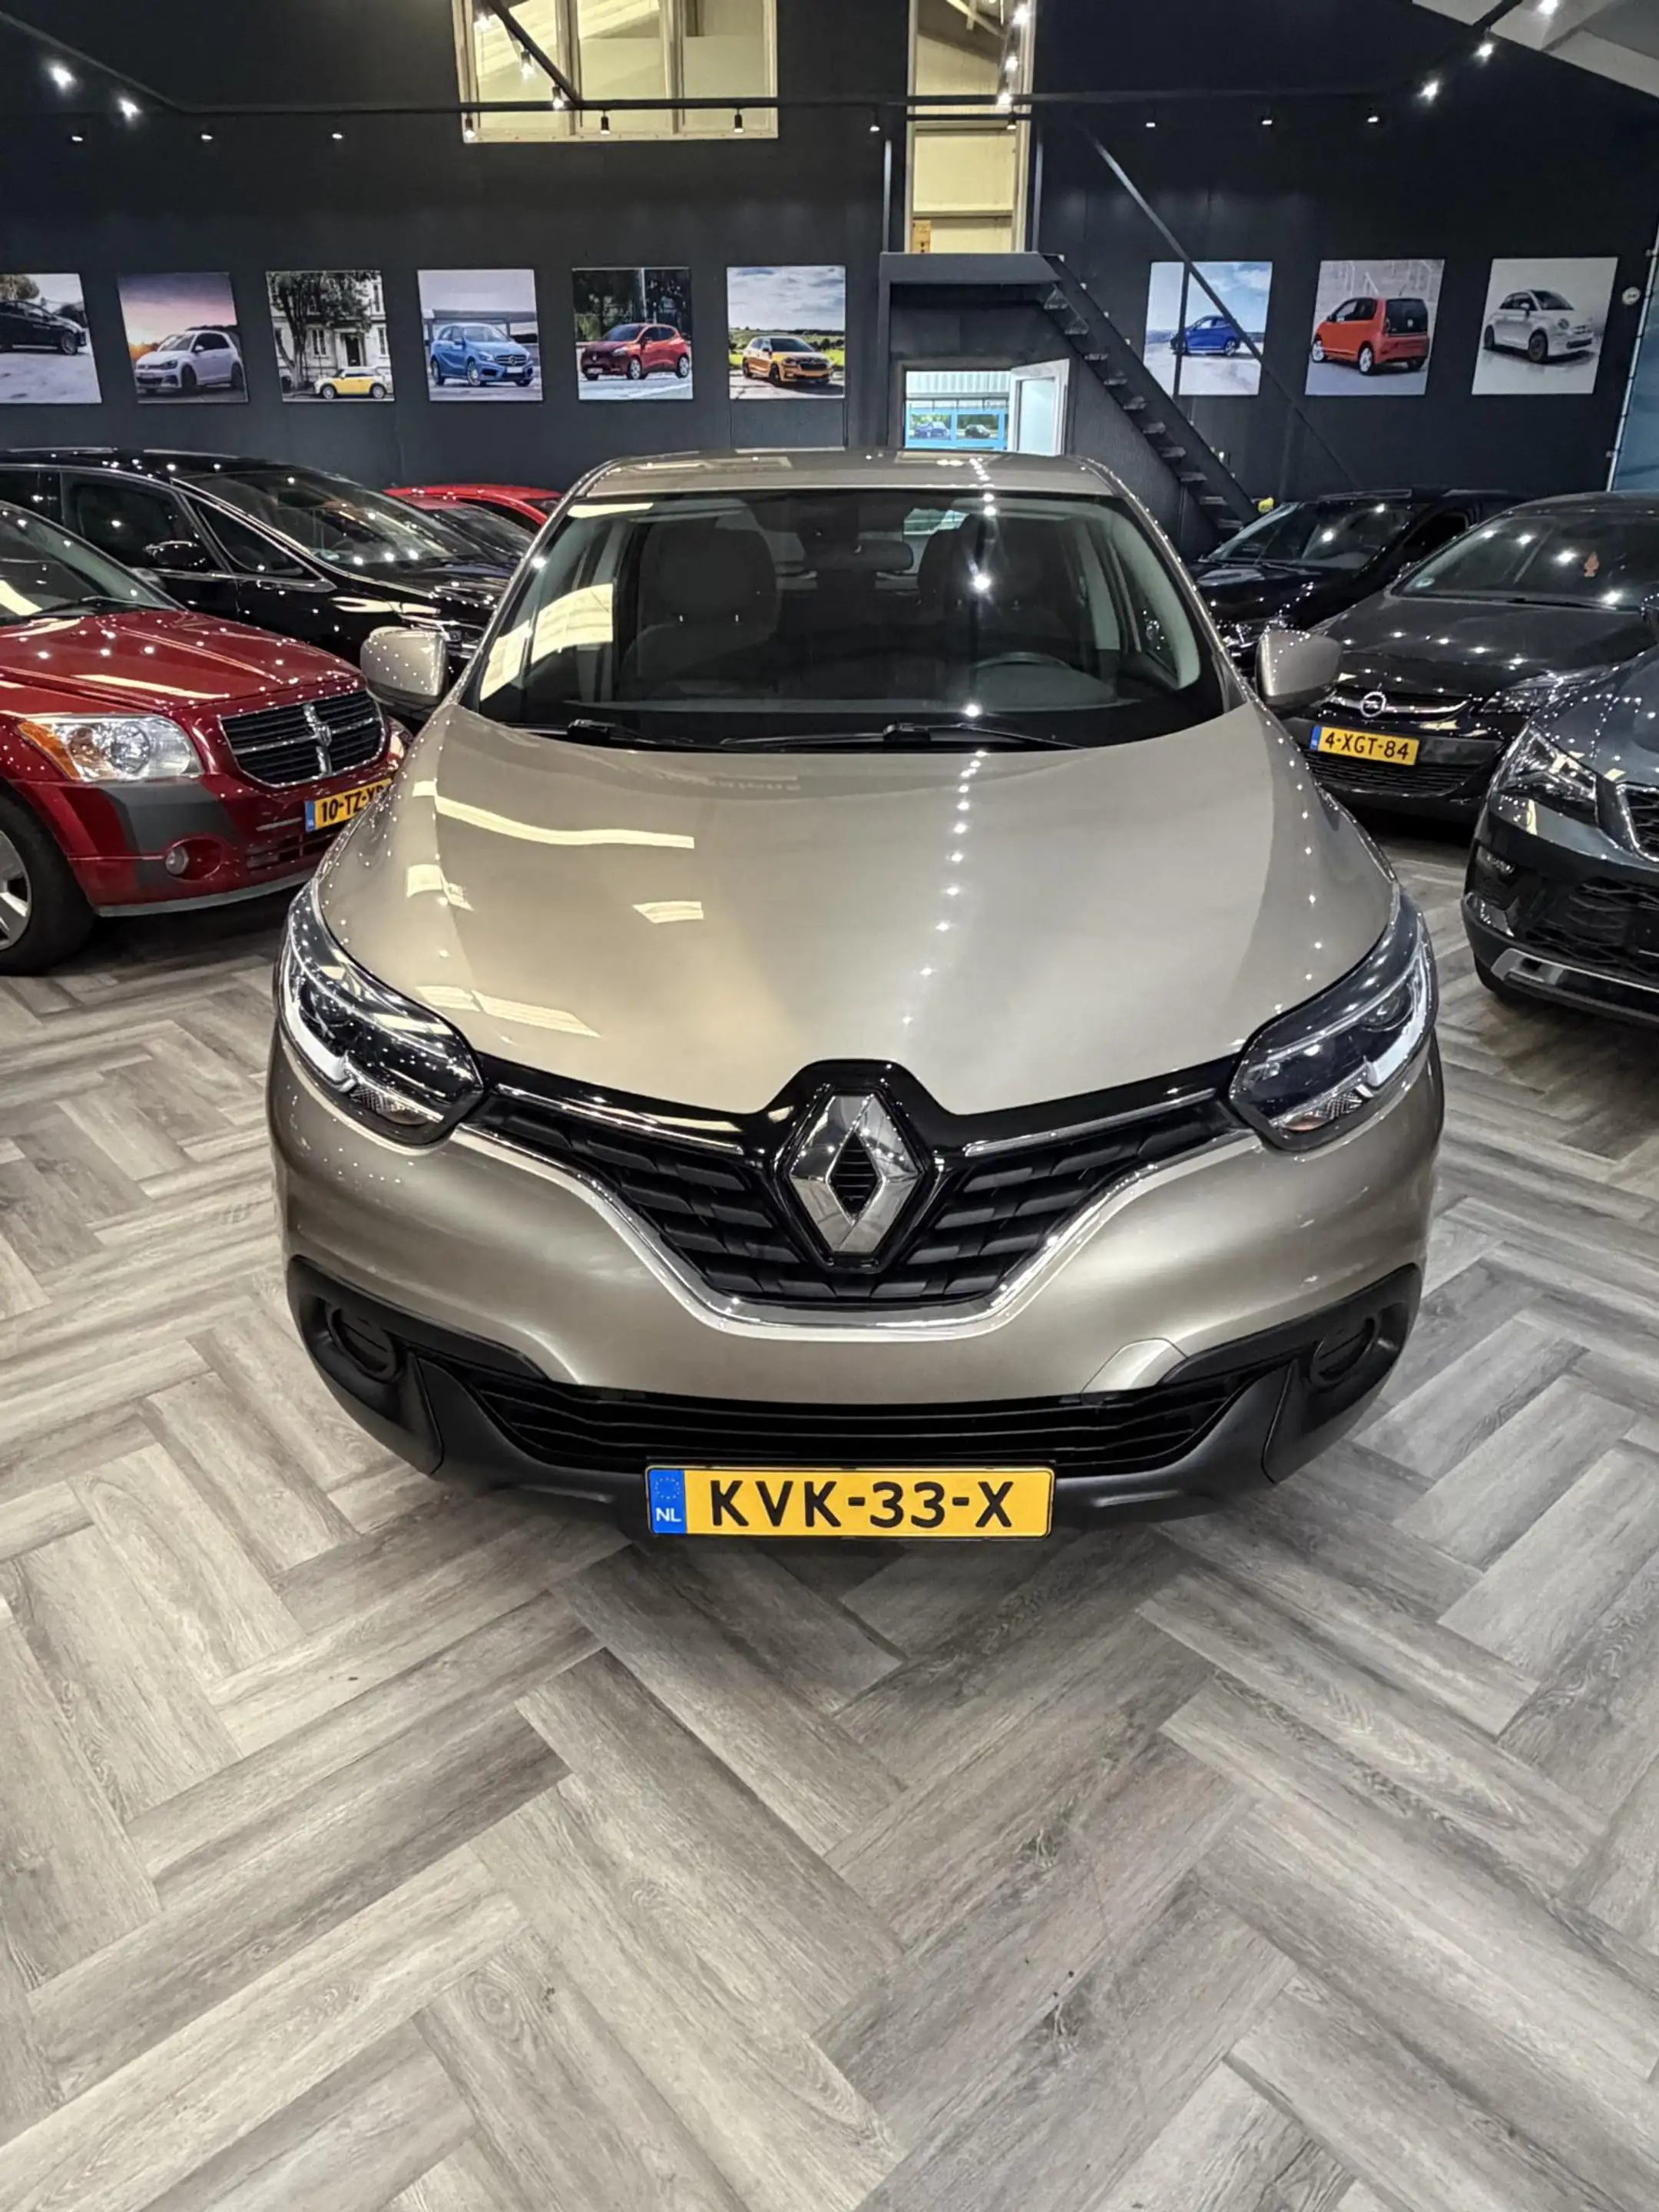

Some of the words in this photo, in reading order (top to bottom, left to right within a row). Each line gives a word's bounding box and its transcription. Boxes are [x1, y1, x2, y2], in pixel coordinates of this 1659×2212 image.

[1325, 731, 1409, 760] 4-XGT-84
[655, 1507, 681, 1522] NL
[710, 1480, 1014, 1528] KVK-33-X
